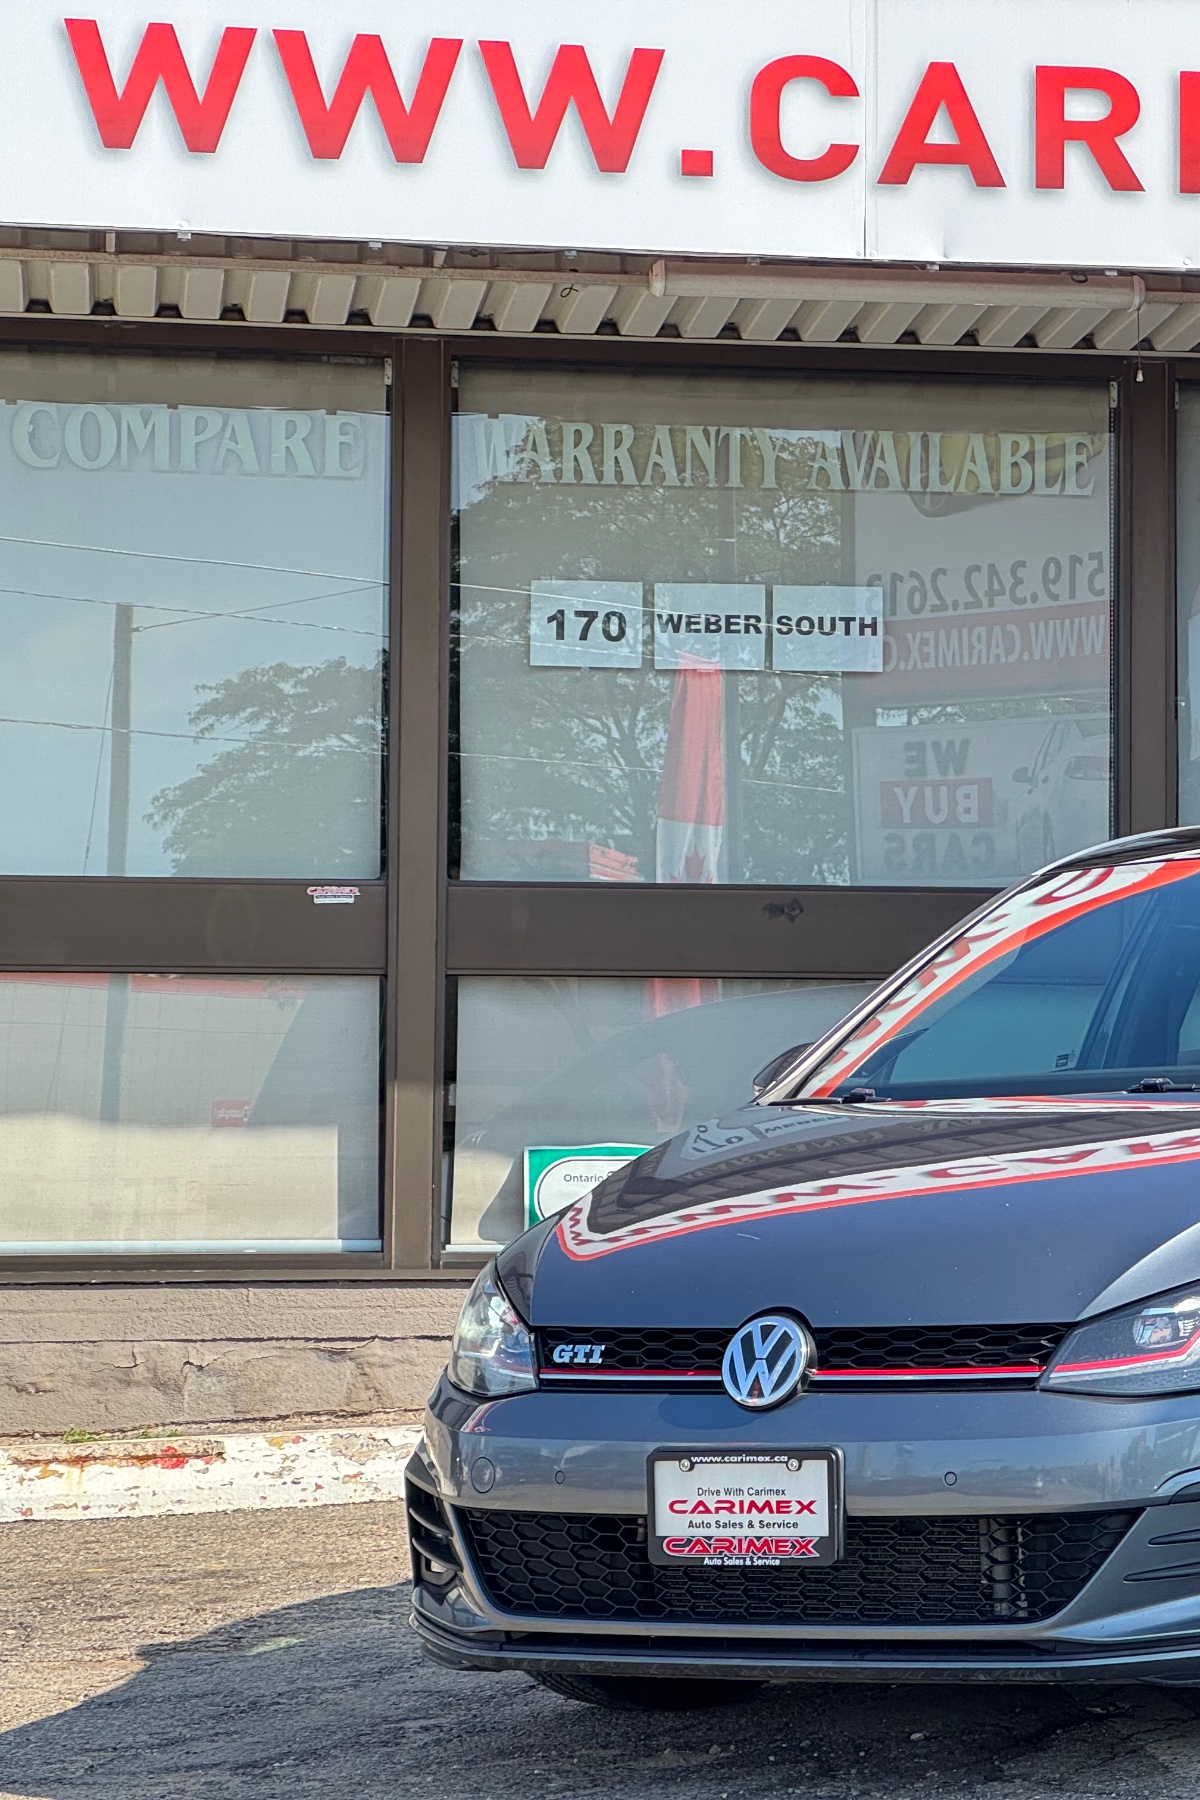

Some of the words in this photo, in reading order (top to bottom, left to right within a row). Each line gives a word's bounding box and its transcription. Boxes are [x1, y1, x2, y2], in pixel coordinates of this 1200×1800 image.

[12, 404, 365, 478] COMPARE
[473, 420, 781, 489] WARRANTY
[807, 429, 1096, 496] AVAILABLE
[546, 609, 627, 642] 170
[656, 613, 764, 635] WEBER
[776, 614, 878, 637] SOUTH
[563, 1173, 604, 1183] Ontario
[553, 1344, 606, 1364] GTI
[723, 1317, 806, 1407] VW
[690, 1454, 789, 1463] www.carimex.ca
[697, 1487, 721, 1497] Drive
[723, 1487, 745, 1497] With
[747, 1487, 787, 1497] Carimex
[668, 1499, 818, 1515] CARIMEX
[687, 1520, 712, 1529] Auto
[714, 1520, 744, 1529] Sales
[747, 1520, 755, 1529] &
[758, 1520, 799, 1529] Service
[664, 1536, 818, 1556] CARIMEX
[703, 1557, 722, 1566] Auto
[723, 1557, 743, 1566] Sales
[744, 1557, 751, 1566] &
[752, 1557, 781, 1566] Service
